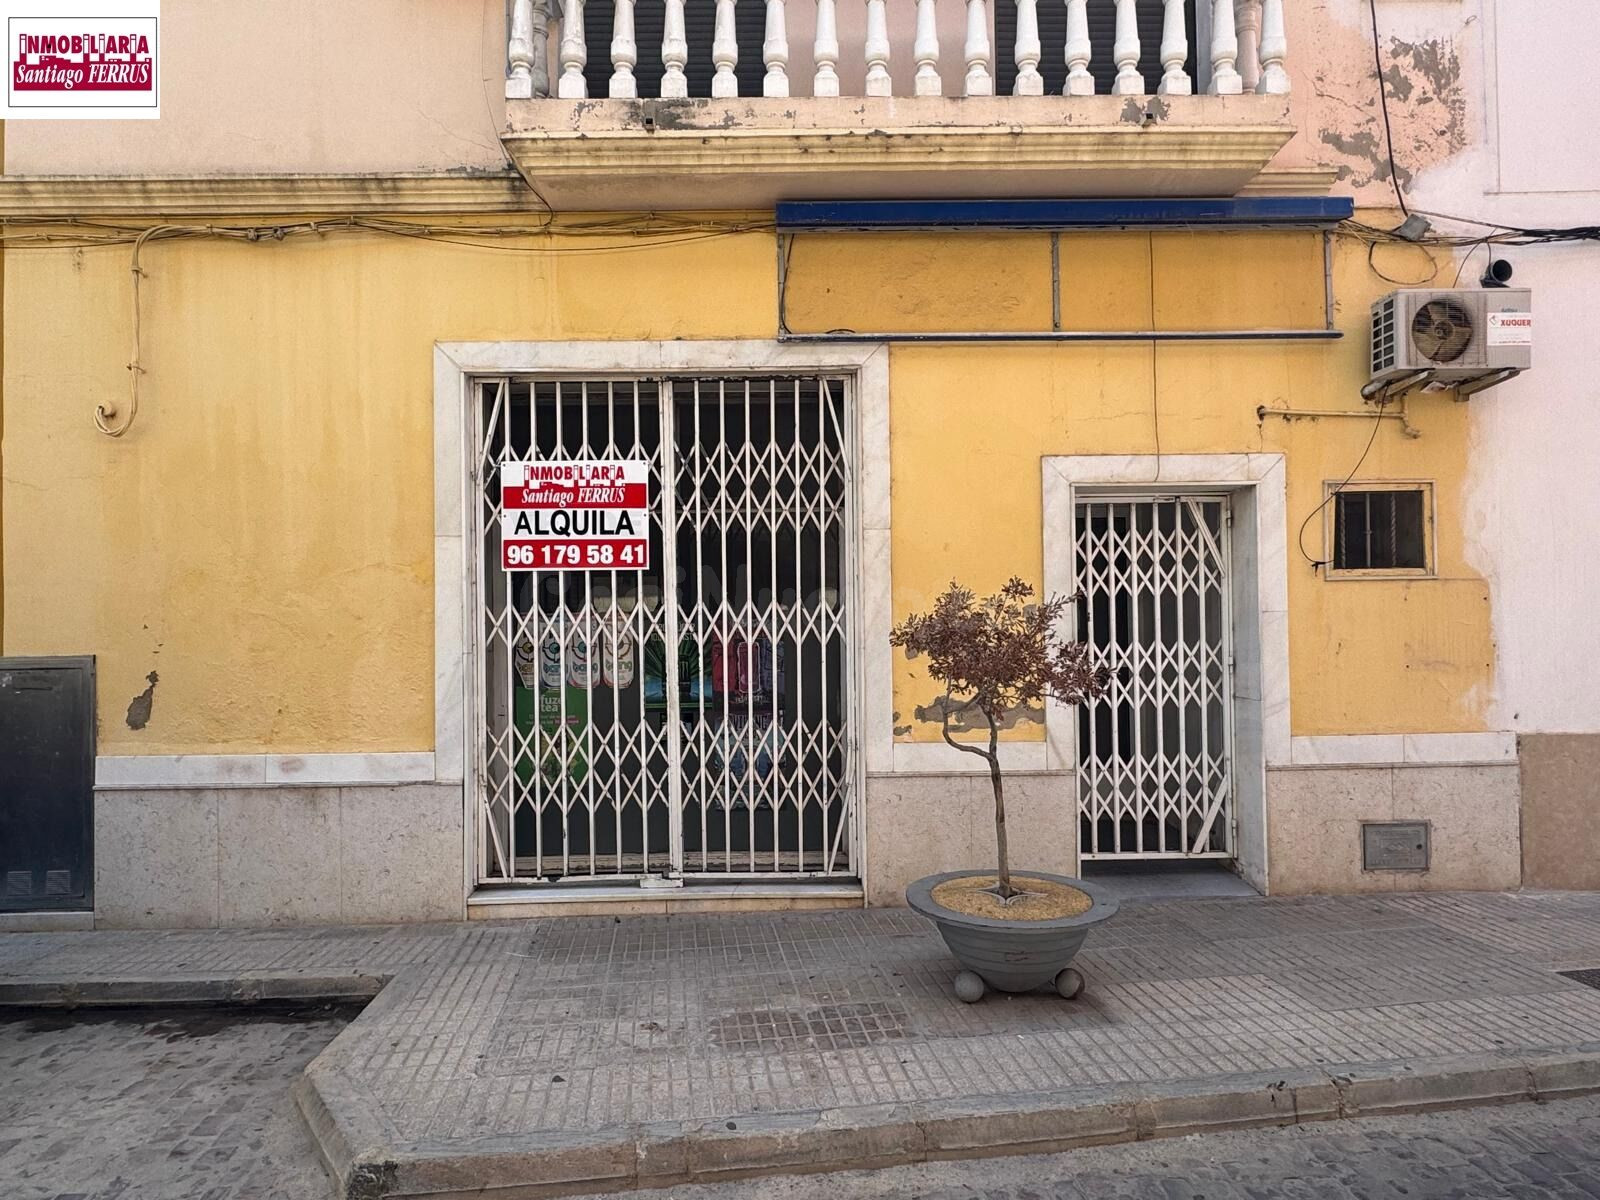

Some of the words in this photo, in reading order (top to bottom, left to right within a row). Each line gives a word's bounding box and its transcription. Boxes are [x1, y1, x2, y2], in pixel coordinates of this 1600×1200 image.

[522, 488, 574, 508] Santiago
[577, 487, 626, 503] FERRUS
[514, 510, 635, 537] ALQUILA
[507, 545, 534, 565] 96
[541, 545, 581, 565] 179
[586, 545, 614, 565] 58
[620, 544, 644, 564] 41
[540, 694, 563, 705] fuz
[540, 703, 559, 712] tea
